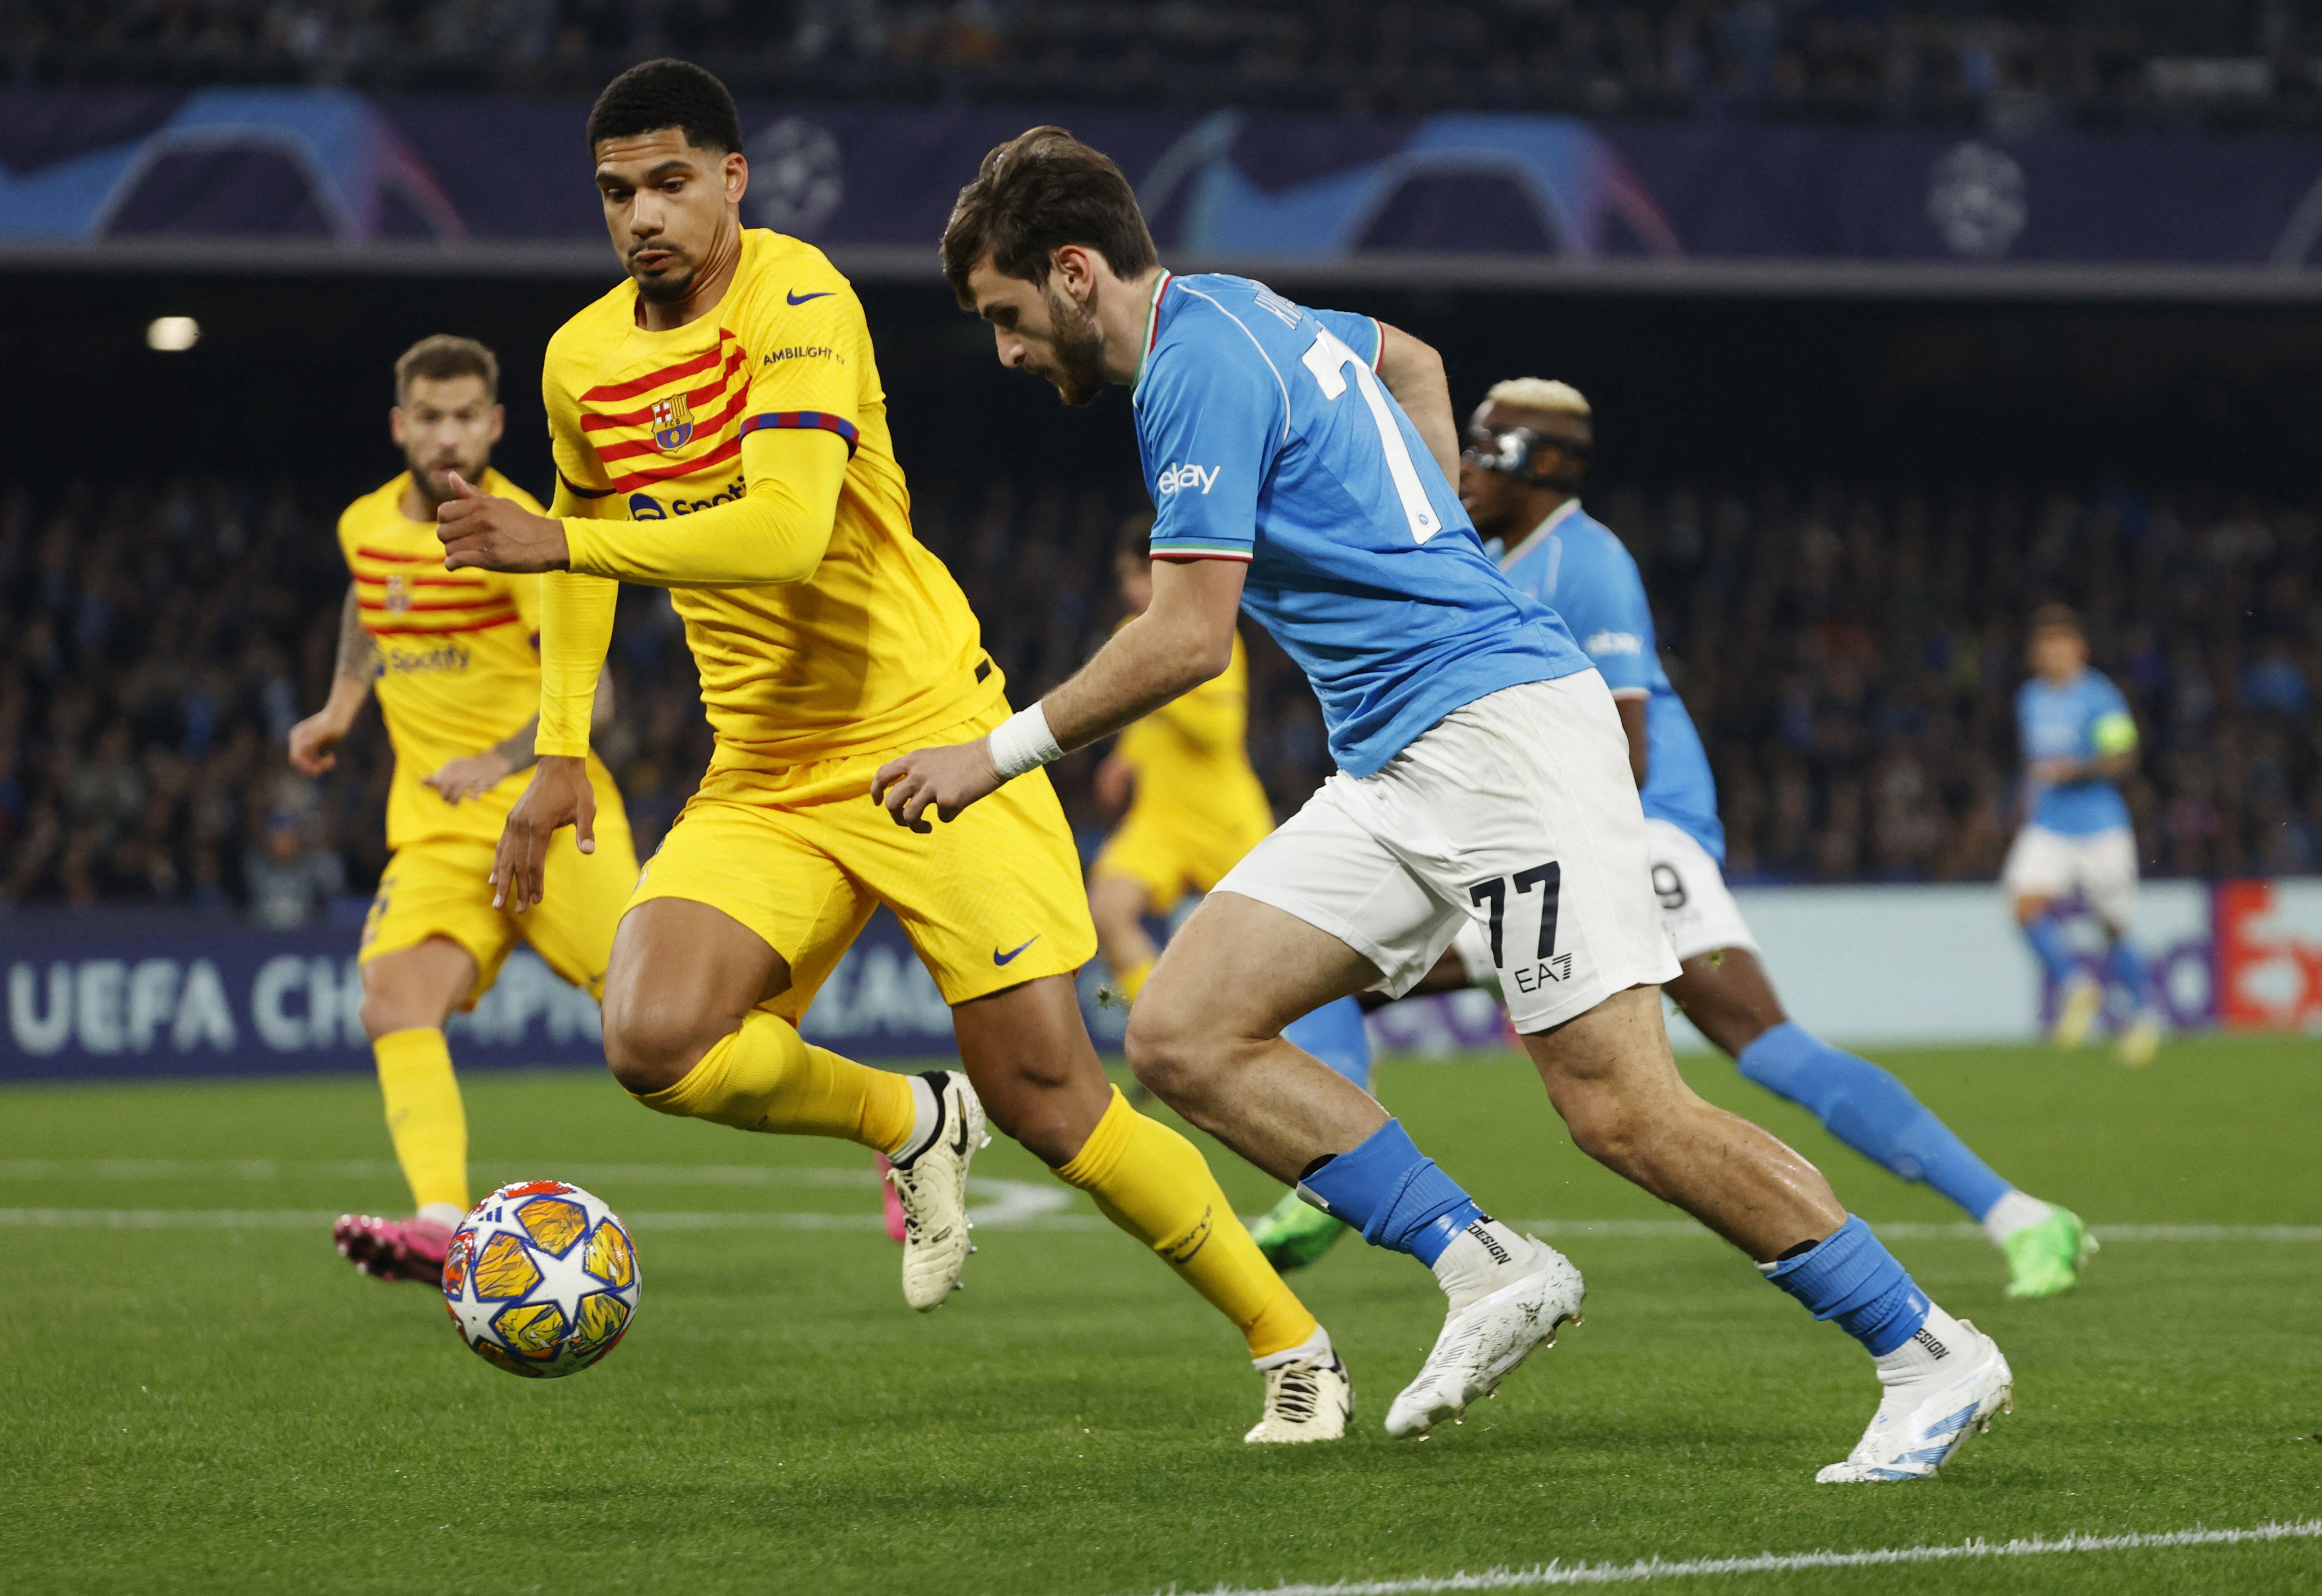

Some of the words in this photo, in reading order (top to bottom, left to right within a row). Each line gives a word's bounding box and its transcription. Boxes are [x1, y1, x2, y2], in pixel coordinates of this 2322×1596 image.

[1651, 863, 1688, 910] 9
[1469, 860, 1561, 969] 77
[1515, 952, 1572, 994] EA7
[8, 956, 236, 1052] UEFA
[1465, 1223, 1512, 1265] DESIGN
[1913, 1327, 1950, 1361] ESIGN
